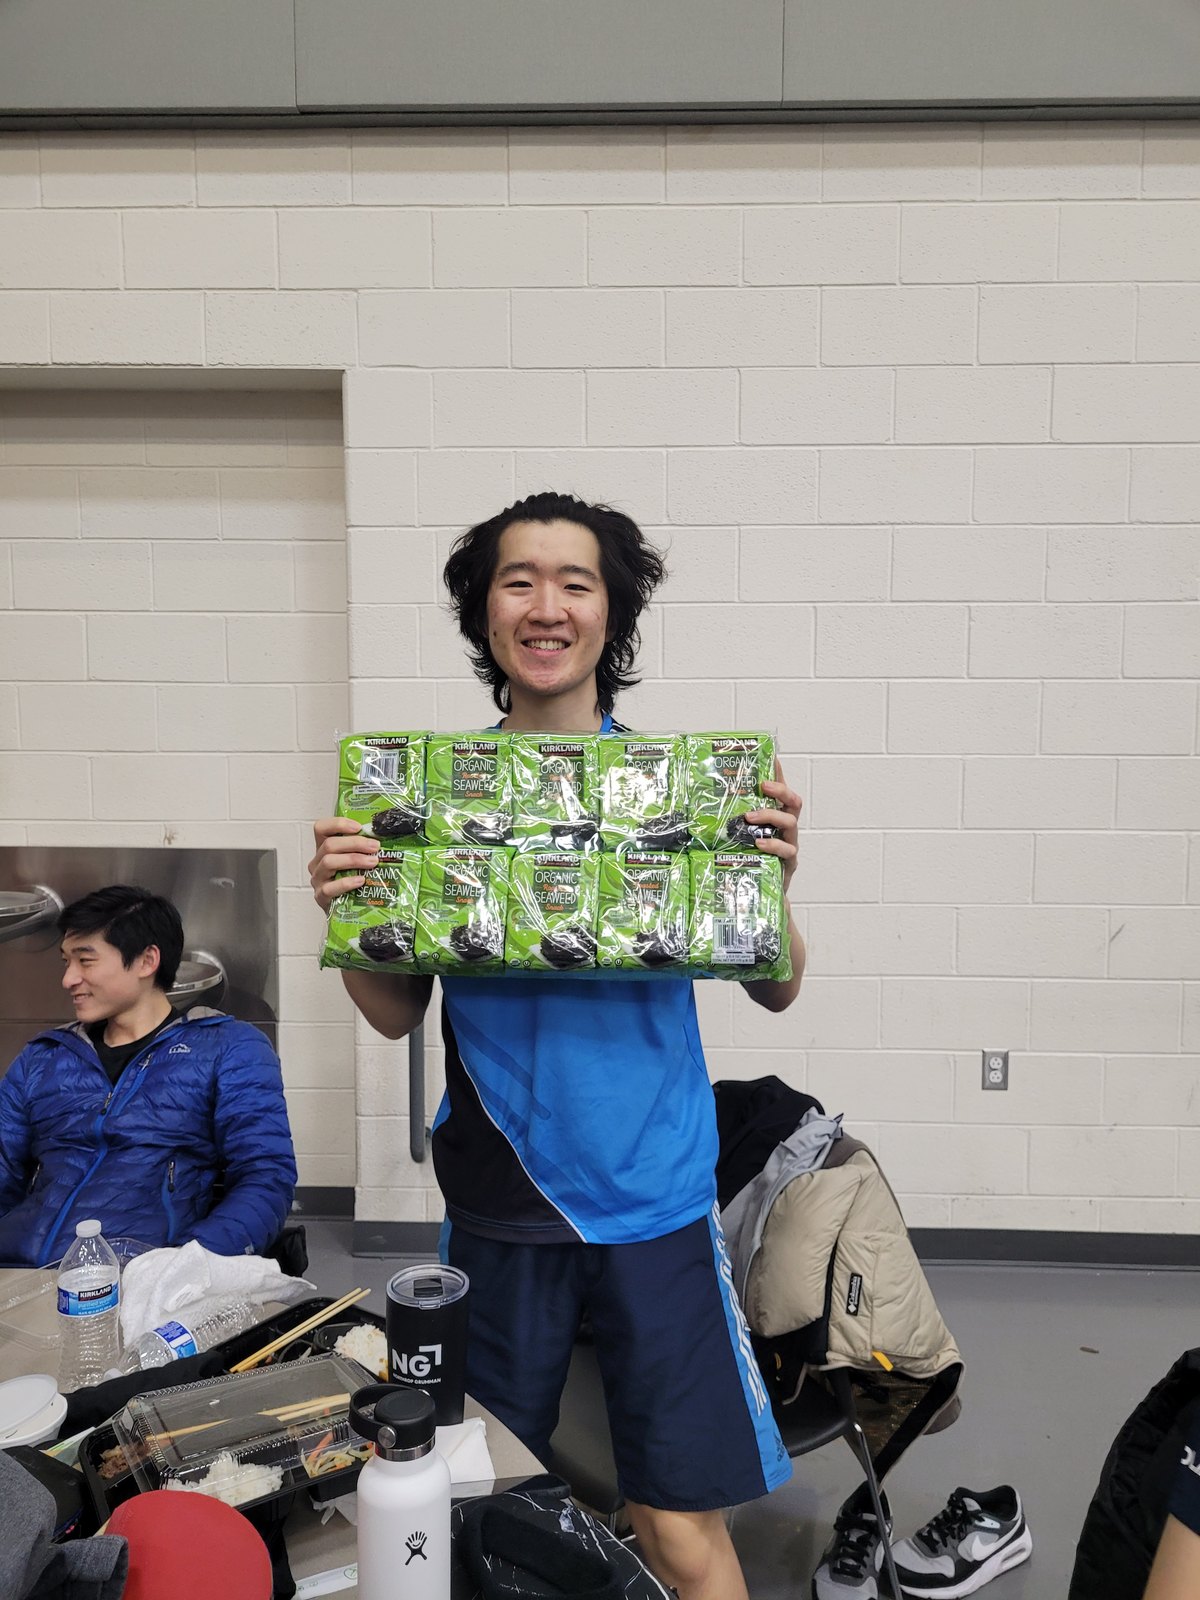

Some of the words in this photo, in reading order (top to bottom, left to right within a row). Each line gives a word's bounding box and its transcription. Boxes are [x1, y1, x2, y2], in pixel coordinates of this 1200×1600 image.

[367, 737, 407, 746] KIRKLAND
[453, 759, 495, 772] ORGANIC
[541, 761, 582, 774] ORGANIC
[627, 760, 663, 772] ORGAN
[715, 756, 756, 769] ORGANIC
[453, 779, 495, 791] SEAWEED
[446, 864, 488, 878] ORGANIC
[535, 871, 577, 884] ORGANIC
[357, 886, 396, 899] SEAWEED
[535, 892, 576, 904] SEAWEED
[80, 1286, 112, 1298] KIRKLAND
